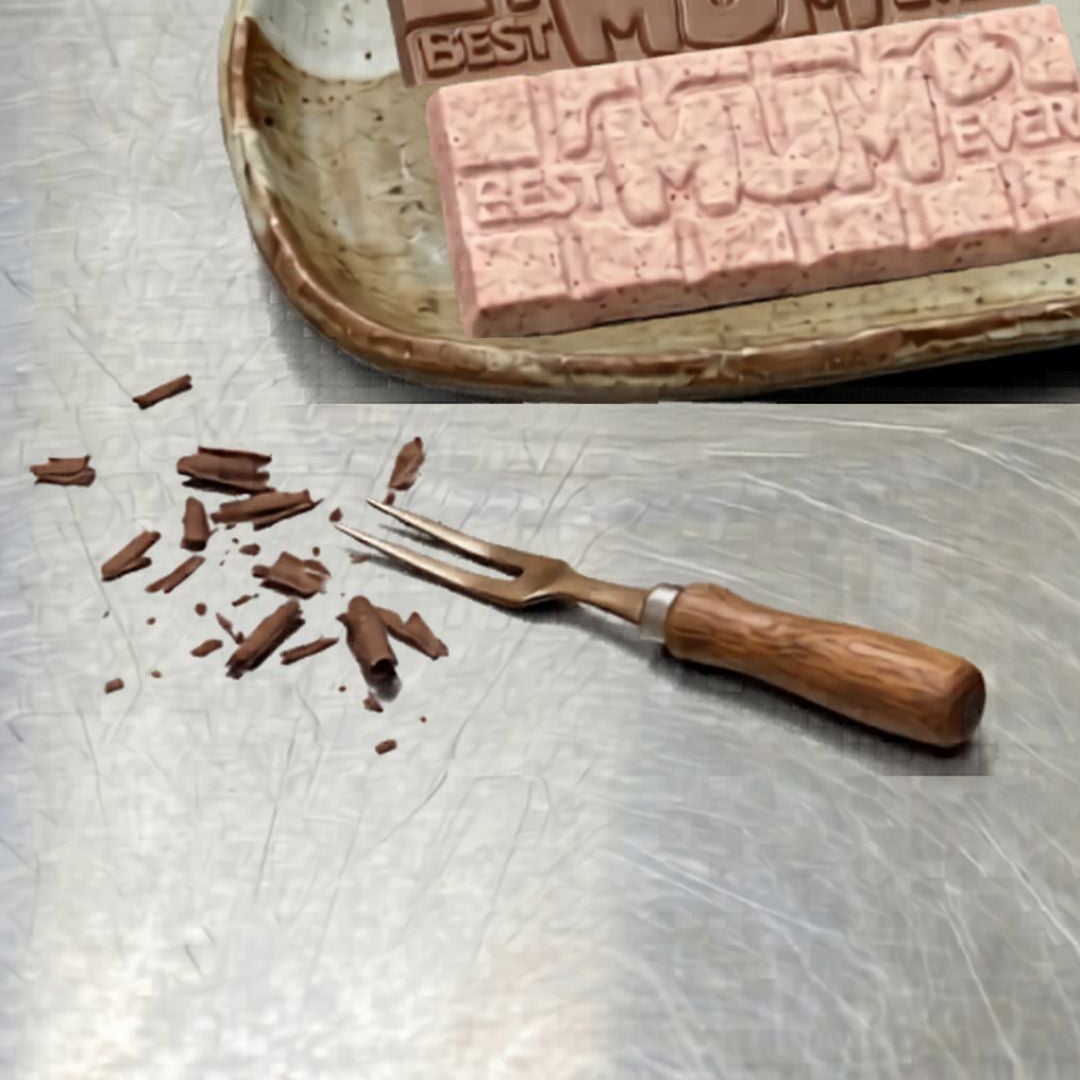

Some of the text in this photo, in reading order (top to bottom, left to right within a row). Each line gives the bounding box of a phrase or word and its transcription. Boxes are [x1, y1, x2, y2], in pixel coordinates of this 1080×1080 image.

[418, 17, 556, 78] BEST
[474, 168, 606, 228] BEST
[600, 62, 946, 228] MUM
